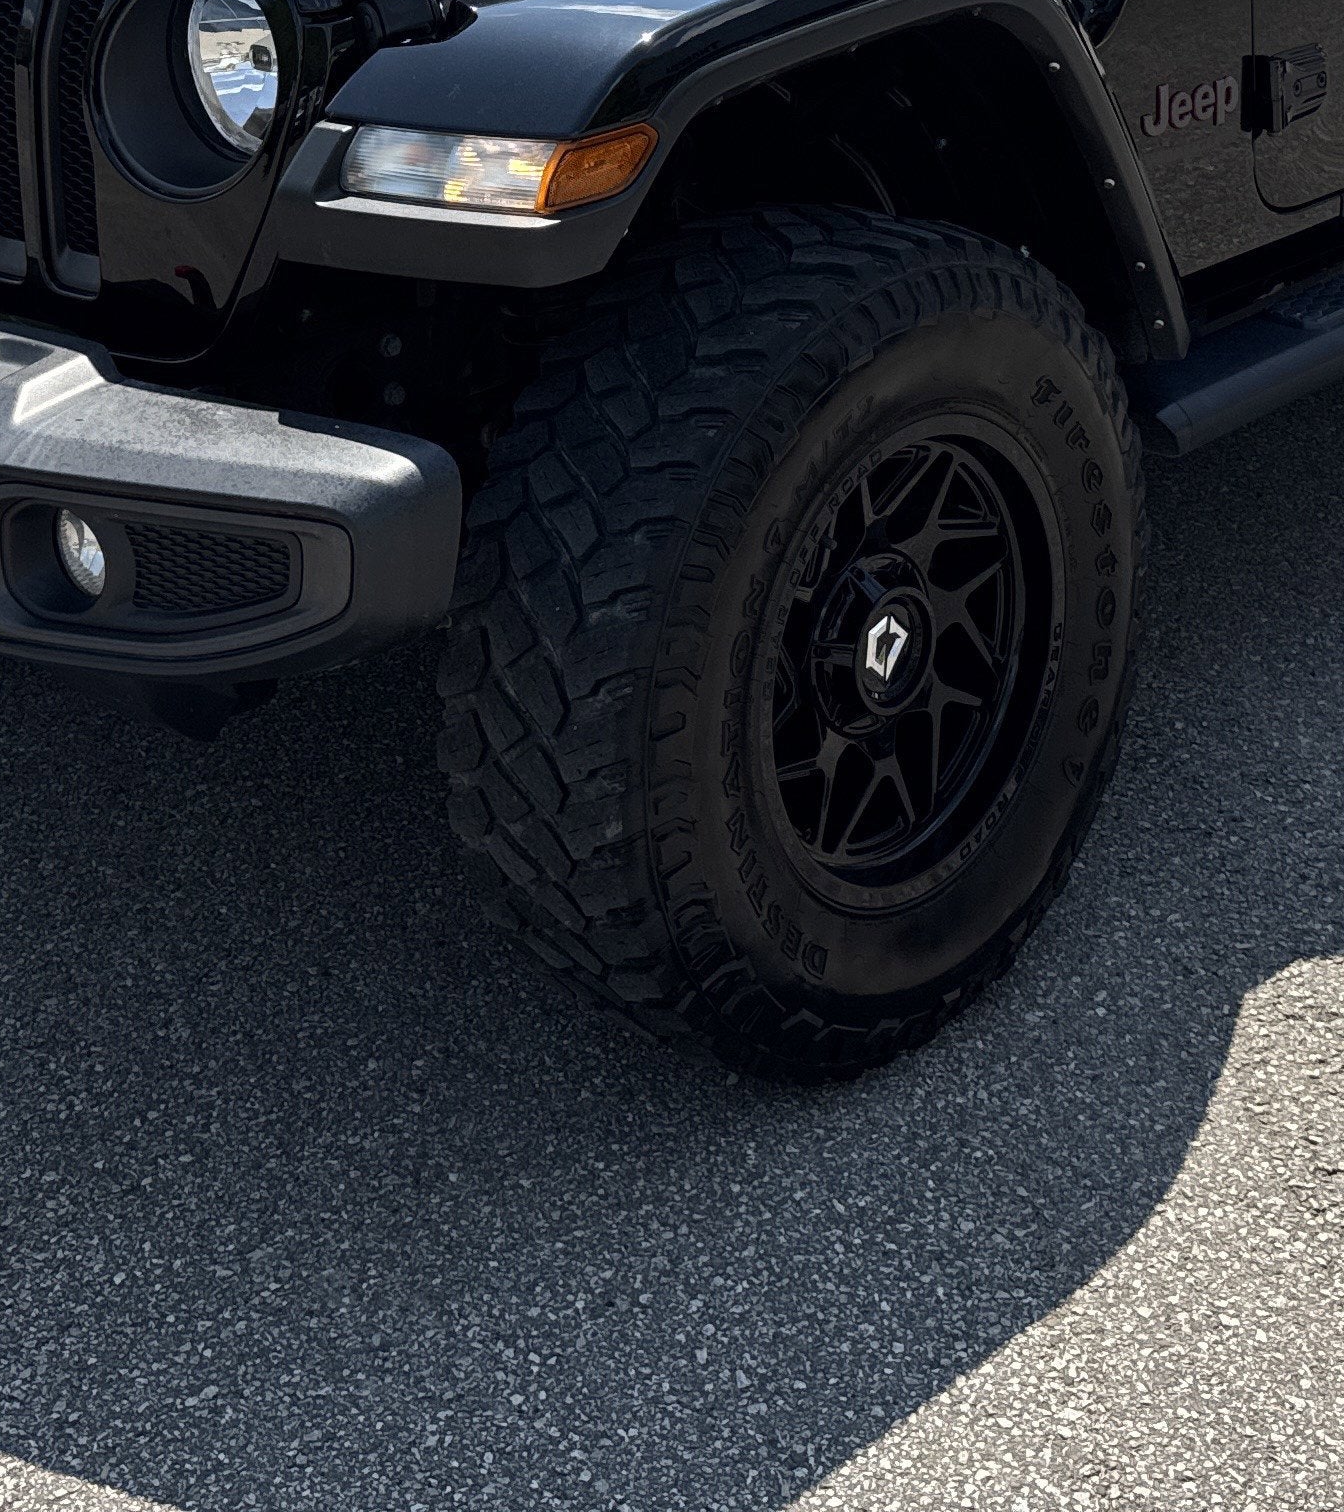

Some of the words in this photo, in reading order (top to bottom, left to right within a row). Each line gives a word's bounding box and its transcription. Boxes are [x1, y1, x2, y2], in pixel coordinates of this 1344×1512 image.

[1140, 75, 1239, 137] Jeep
[827, 448, 883, 515] ROAD
[1030, 374, 1118, 736] Firestone
[722, 573, 829, 980] DESTINATION
[959, 793, 1011, 861] ROAD
